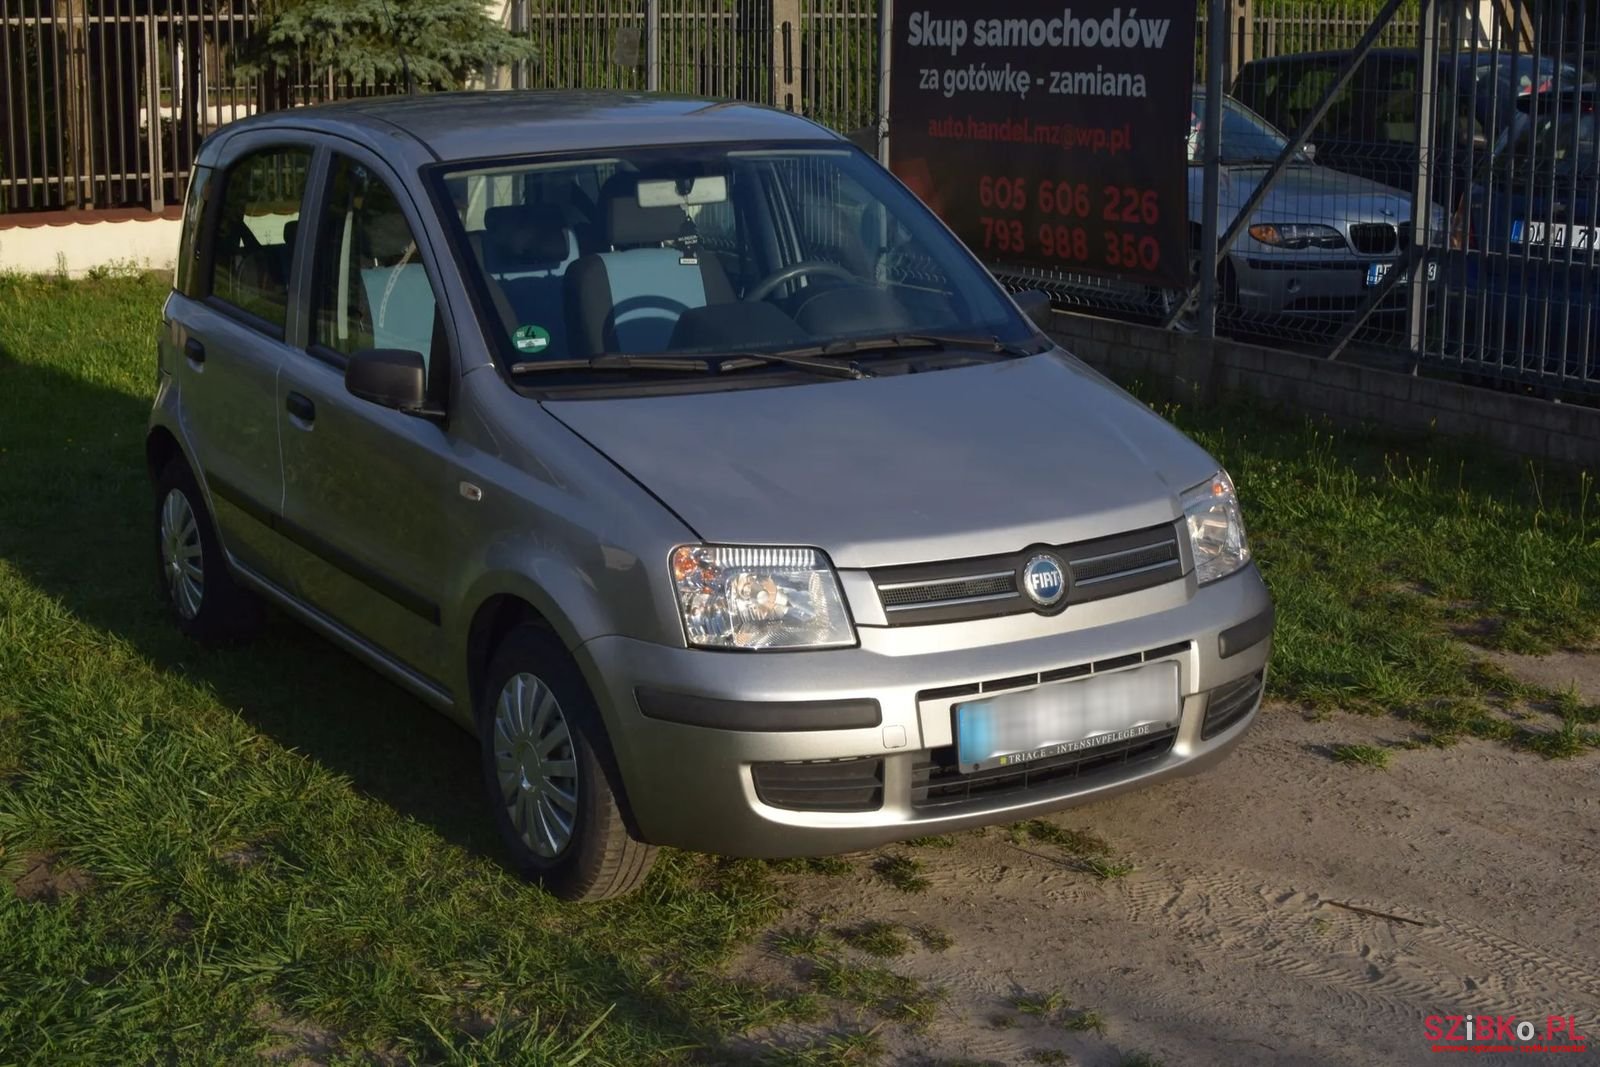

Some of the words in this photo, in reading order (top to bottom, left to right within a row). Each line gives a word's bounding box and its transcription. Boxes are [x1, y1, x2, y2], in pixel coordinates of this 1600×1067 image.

[907, 11, 968, 56] Skup
[973, 8, 1170, 49] samochodów
[919, 68, 939, 90] za
[943, 62, 1031, 100] gotówkę
[1049, 65, 1147, 98] zamiana
[928, 115, 1132, 156] auto.handel.mz@wp.pl
[979, 175, 1026, 211] 605
[1039, 180, 1090, 217] 606
[1103, 186, 1159, 225] 226
[980, 217, 1025, 253] 793
[1039, 224, 1088, 261] 988
[1105, 232, 1160, 271] 350
[525, 326, 536, 339] 4
[1031, 570, 1058, 590] FIAT
[1056, 725, 1150, 754] INTENSIVPFLEGE.DE
